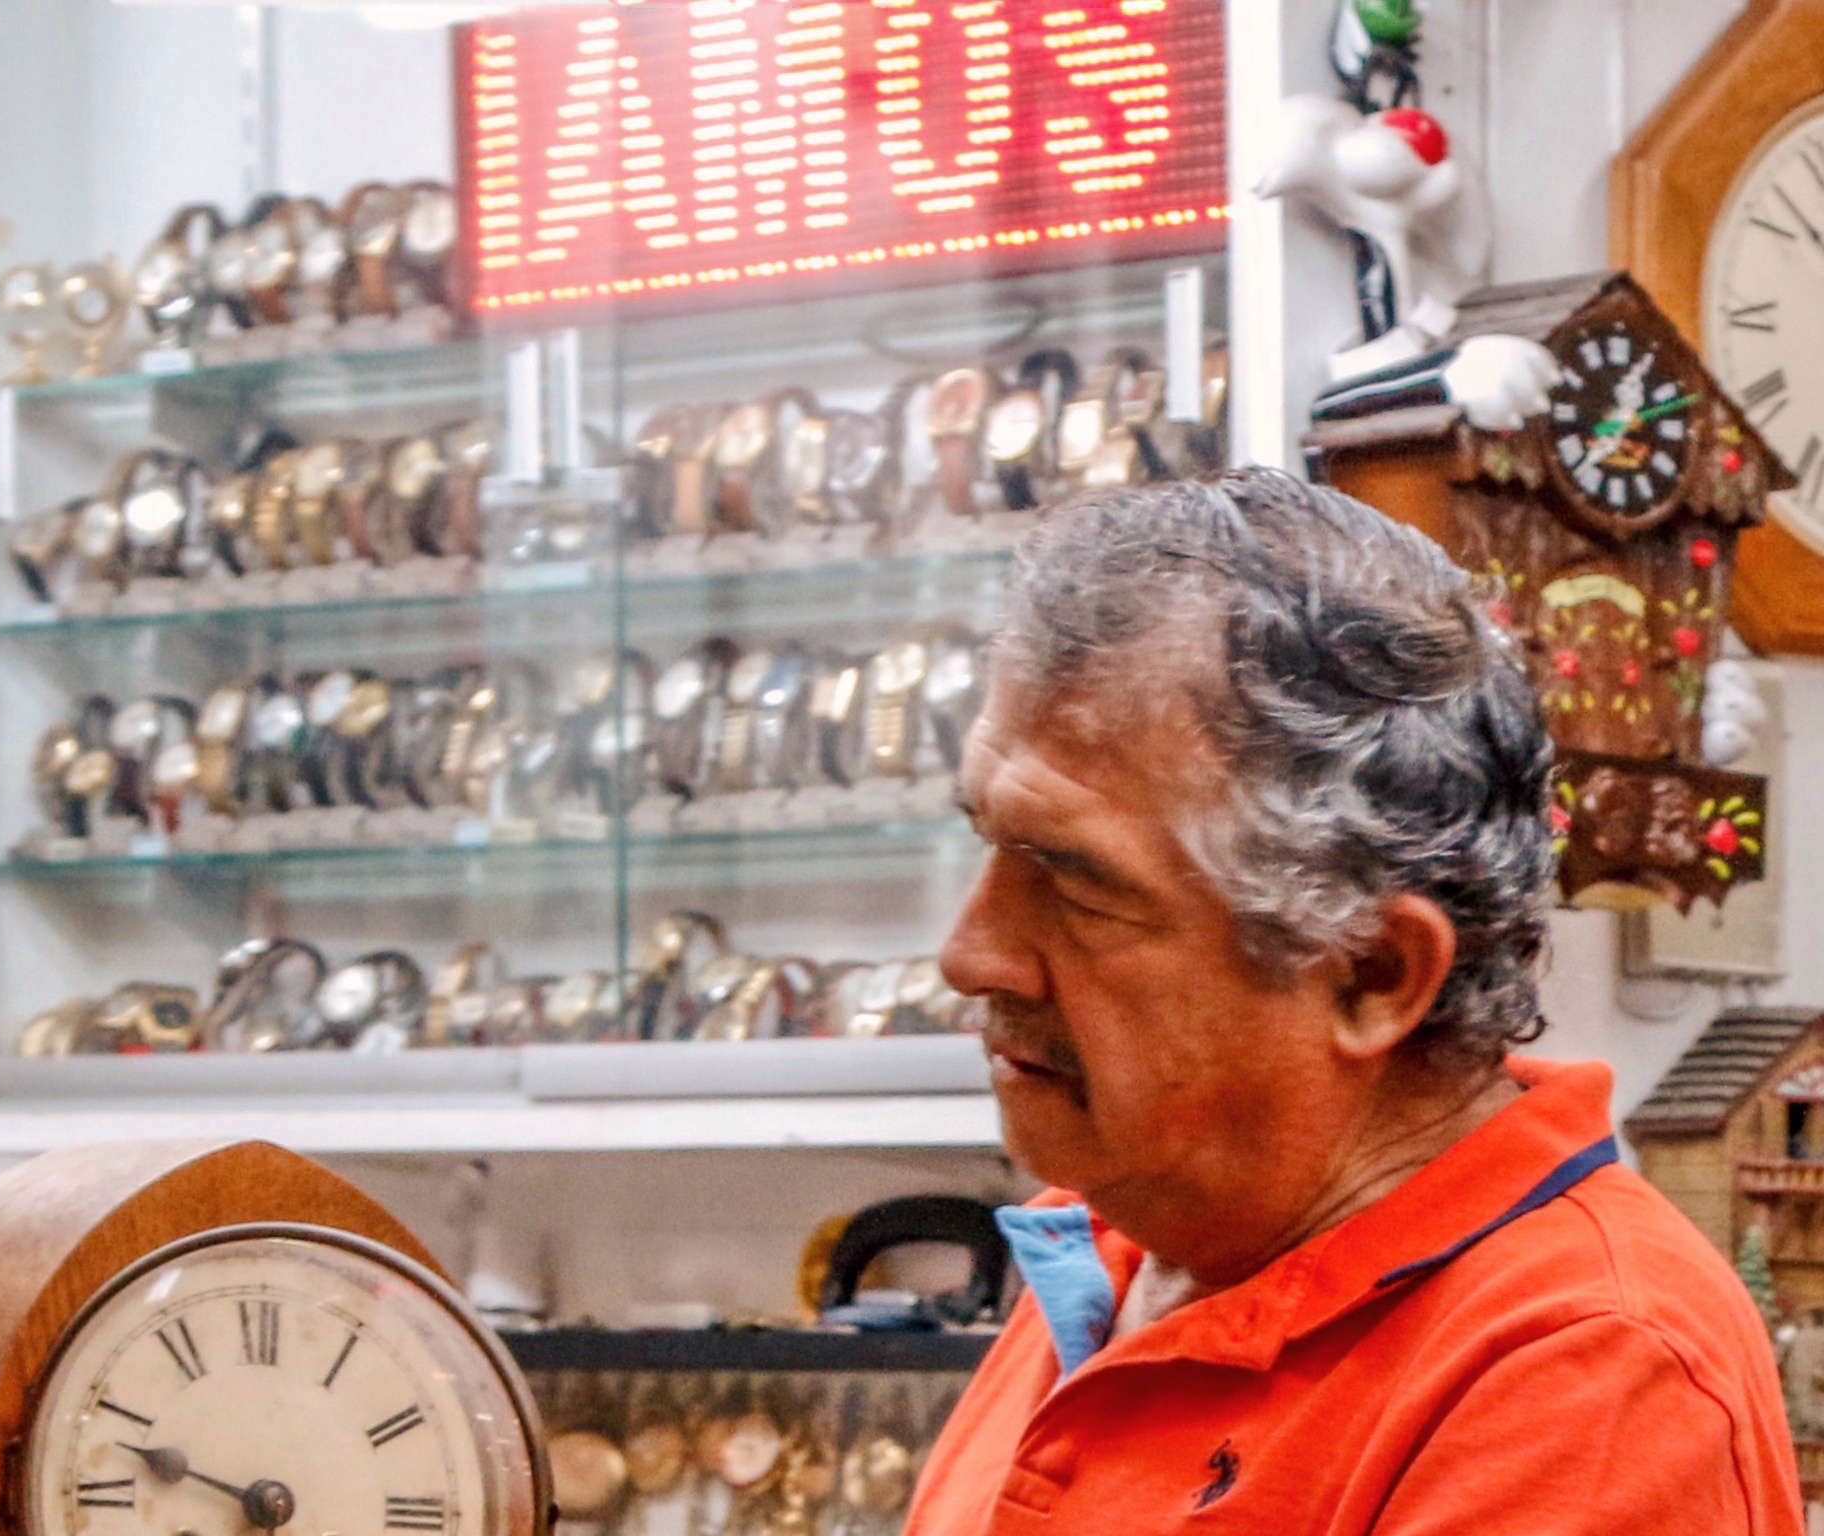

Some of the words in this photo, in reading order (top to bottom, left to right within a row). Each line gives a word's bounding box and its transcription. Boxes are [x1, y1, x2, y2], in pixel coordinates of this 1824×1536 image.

[322, 1333, 359, 1388] I
[368, 1404, 425, 1448] II
[384, 1496, 444, 1530] III
